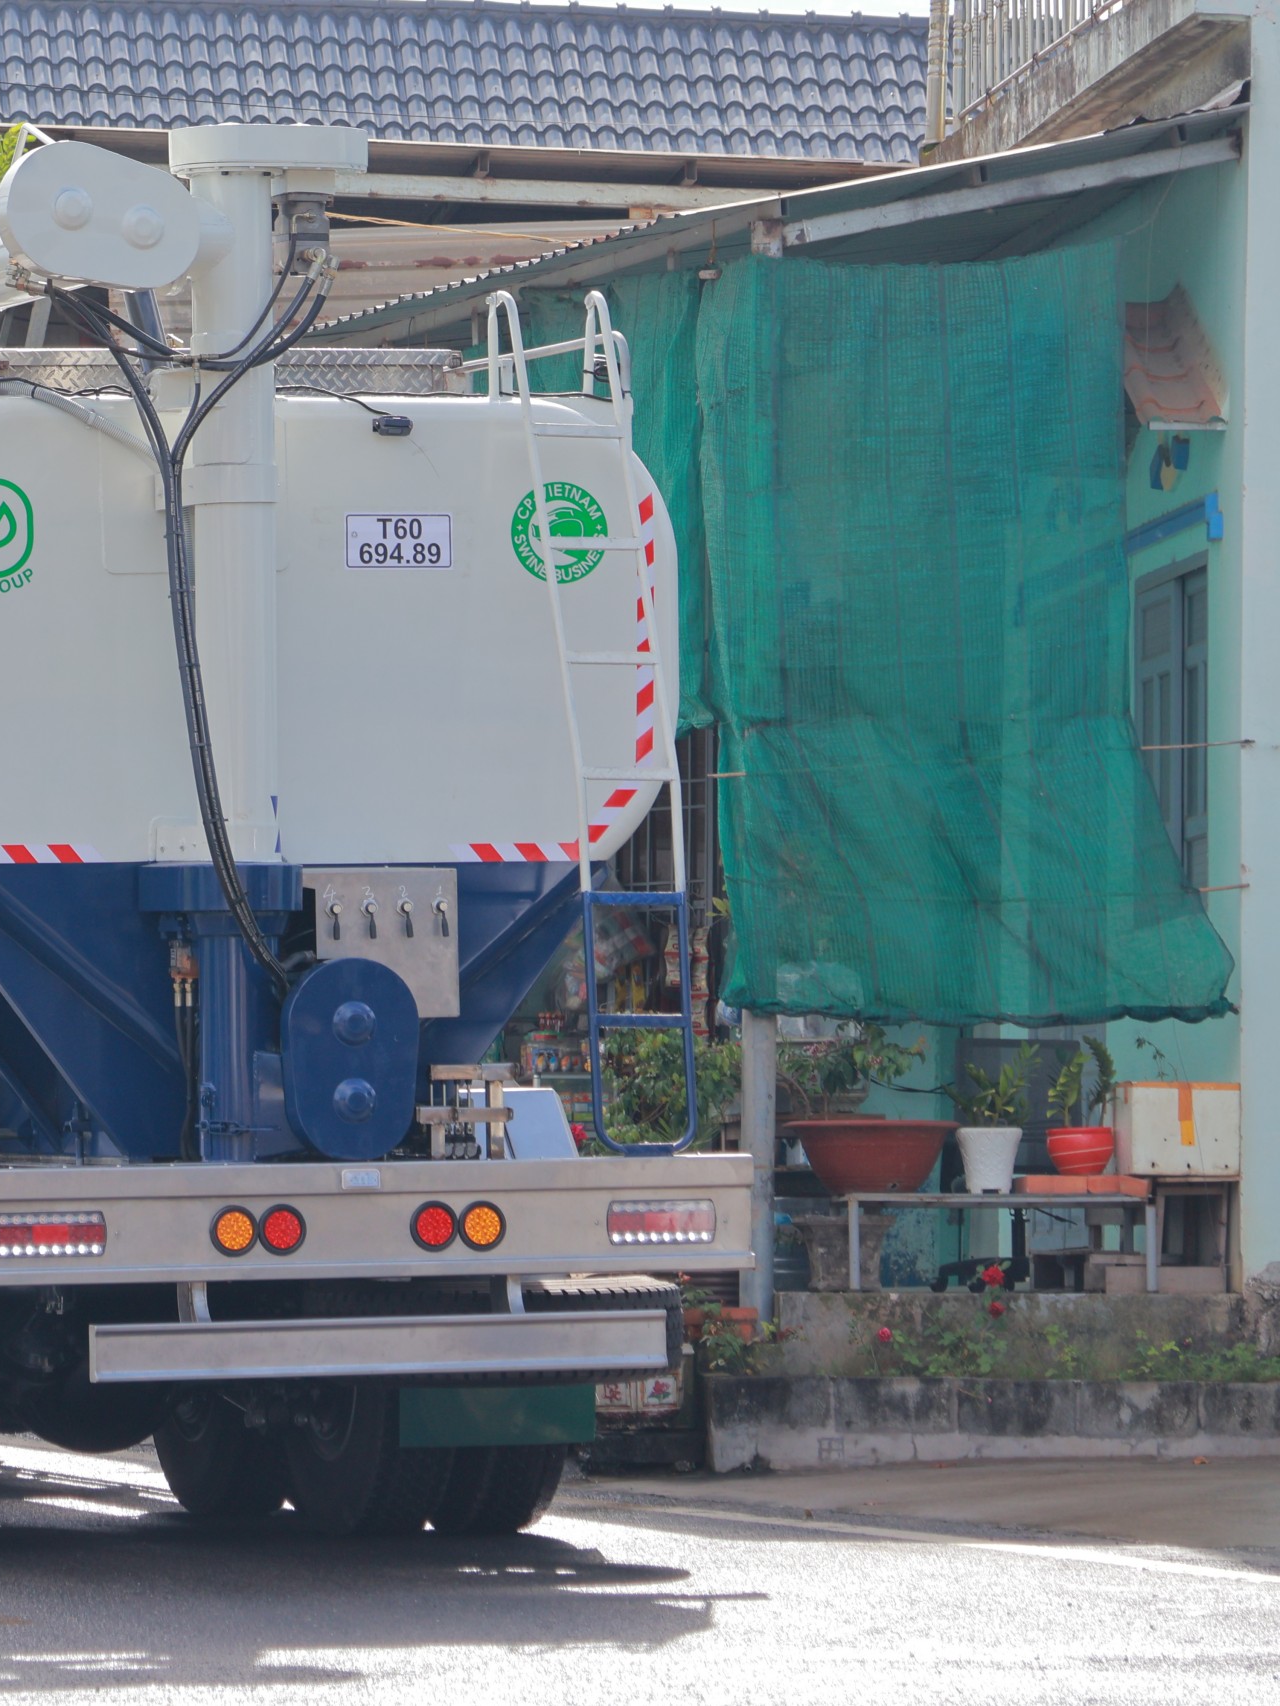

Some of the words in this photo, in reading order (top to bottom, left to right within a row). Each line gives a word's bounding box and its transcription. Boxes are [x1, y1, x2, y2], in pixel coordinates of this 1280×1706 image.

[376, 518, 422, 540] T60
[359, 542, 441, 564] 694.89
[554, 533, 606, 581] BUSINE
[322, 883, 337, 902] 4
[361, 885, 376, 899] 3
[399, 884, 409, 898] 2
